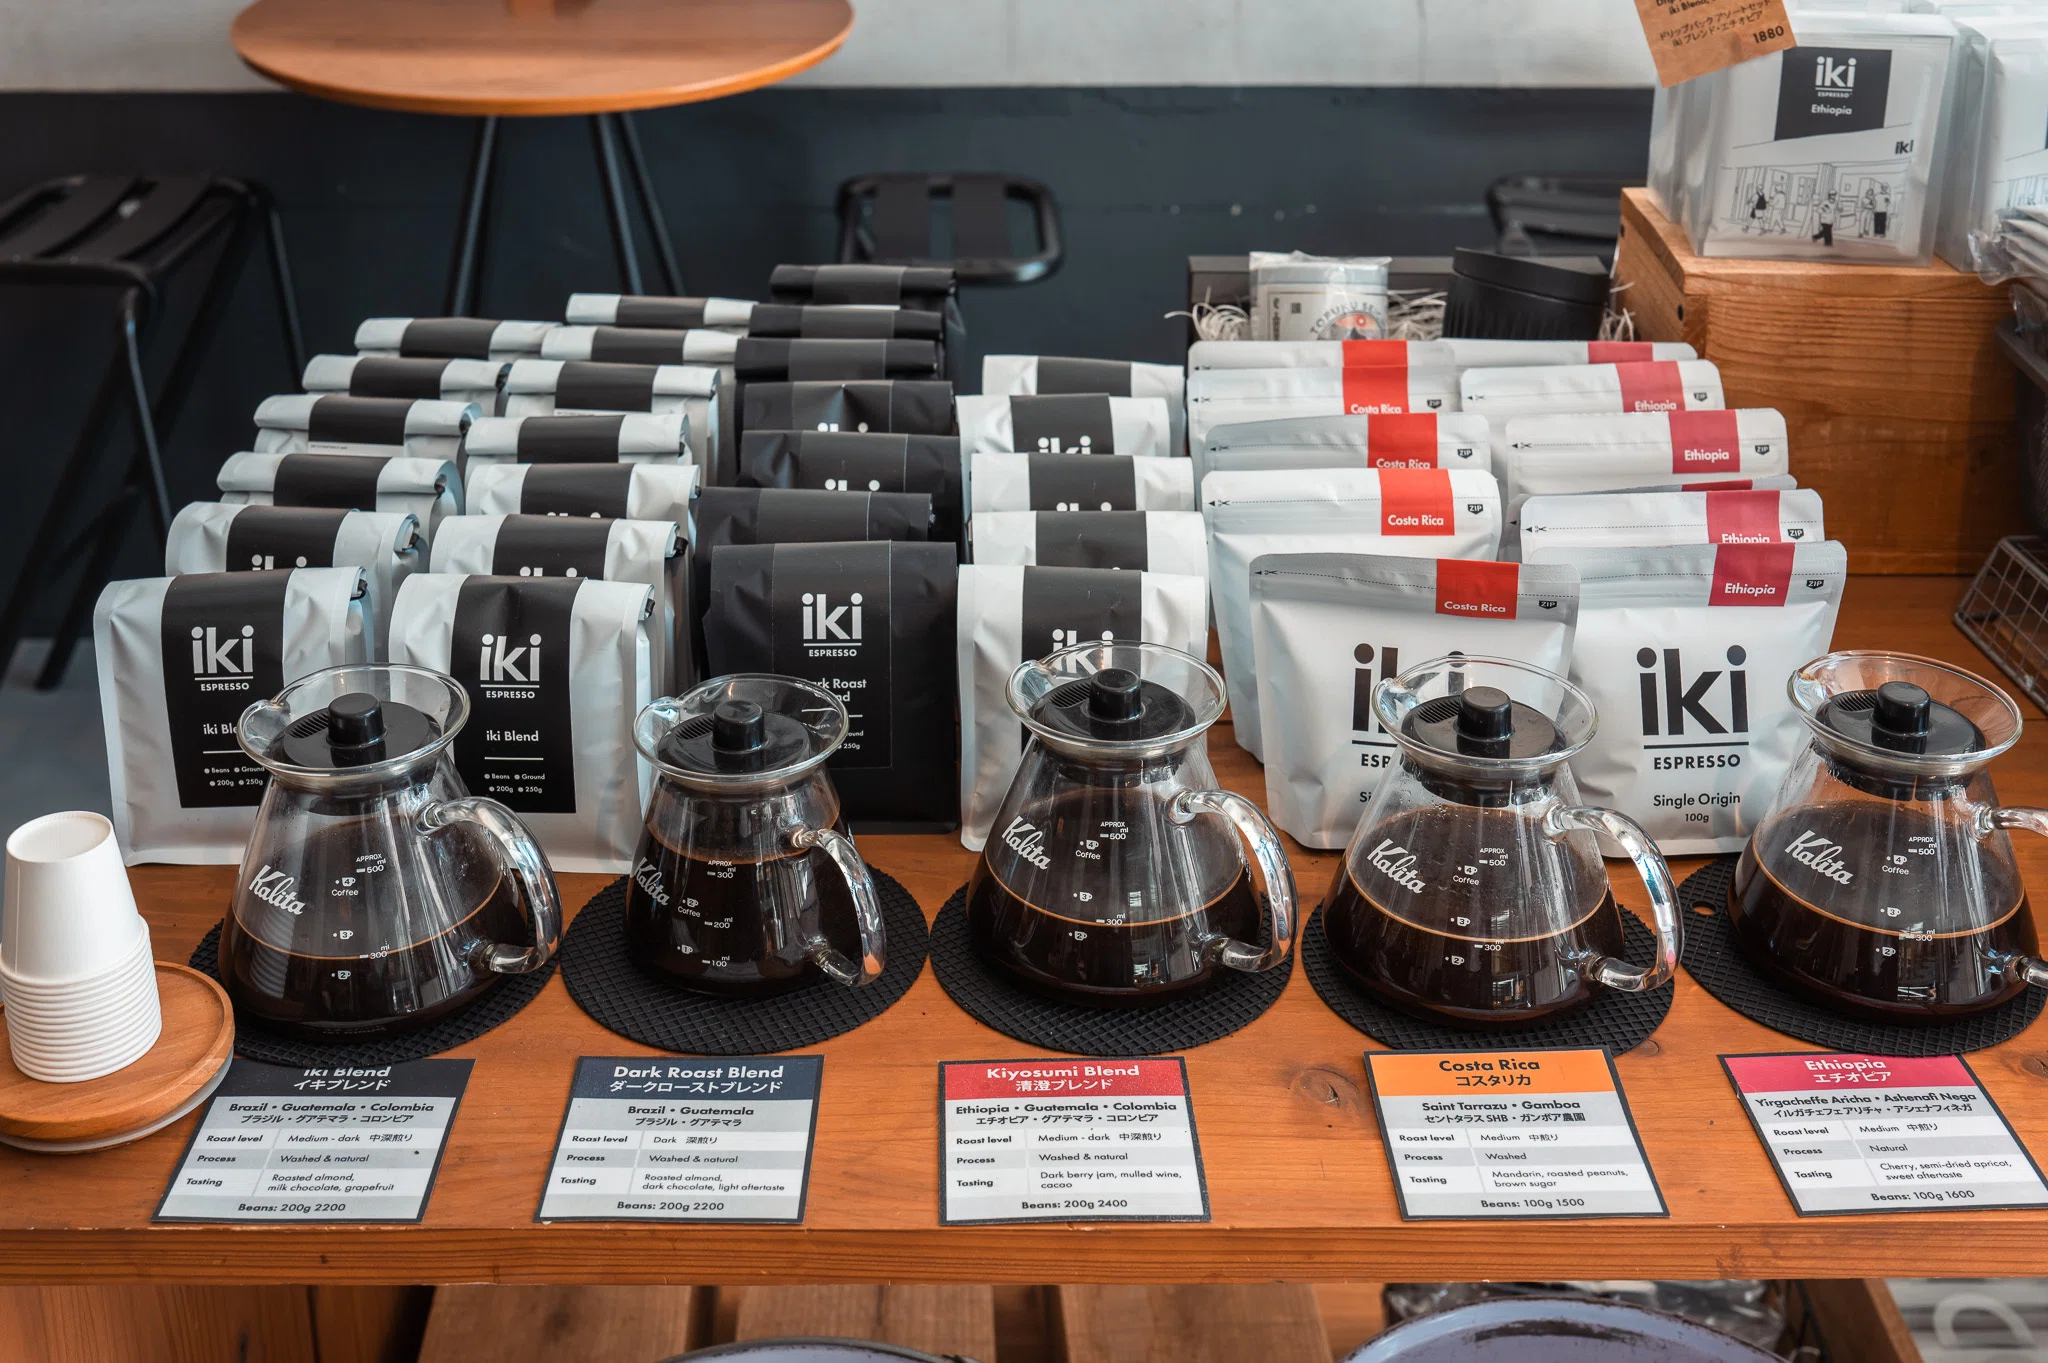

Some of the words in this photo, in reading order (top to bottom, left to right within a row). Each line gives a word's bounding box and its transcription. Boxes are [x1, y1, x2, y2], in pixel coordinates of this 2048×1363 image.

[1753, 26, 1784, 43] 1880
[1816, 56, 1856, 87] iki
[1811, 104, 1852, 116] Ethiopia
[1685, 449, 1729, 463] Ethiopia
[1388, 515, 1418, 526] Costa
[1422, 514, 1444, 526] Rica
[1725, 582, 1775, 596] Ethiopia
[1444, 601, 1478, 611] Costa
[1481, 603, 1505, 613] Rica
[802, 593, 863, 640] iki
[191, 625, 254, 674] iki
[480, 634, 542, 681] iki
[200, 682, 250, 691] ESPRESSO
[833, 679, 866, 688] Roast
[1636, 645, 1749, 736] iki
[203, 723, 217, 734] iki
[486, 730, 500, 741] iki
[505, 731, 538, 741] Blend
[1654, 754, 1740, 770] ESPRESSO
[1654, 794, 1695, 808] Single
[1698, 792, 1740, 808] Origin
[1684, 813, 1709, 823] 100g
[1002, 816, 1050, 870] Kalita
[356, 853, 382, 863] APPROX
[1076, 850, 1100, 860] Coffee
[1785, 830, 1853, 885] Kalita
[1367, 838, 1426, 894] Kalita
[630, 857, 670, 906] Kalita
[249, 865, 305, 915] Kalita
[370, 951, 387, 959] 300
[1439, 1060, 1493, 1072] Costa
[1499, 1059, 1540, 1070] Rica
[1804, 1059, 1887, 1071] Ethiopia
[334, 1067, 391, 1077] Blend
[614, 1066, 662, 1078] Dark
[668, 1067, 723, 1078] Roast
[728, 1066, 784, 1078] Blend
[987, 1066, 1078, 1080] Kiyosumi
[1084, 1065, 1140, 1077] Blend
[1456, 1074, 1532, 1087] コスタリカ
[1813, 1071, 1891, 1084] エチオピア
[294, 1079, 391, 1090] イキブレンド
[610, 1080, 783, 1094] ダークローストブレンド
[1016, 1079, 1112, 1092] 清澄ブレンド
[1755, 1095, 1829, 1108] Yirgacheffe
[1832, 1094, 1871, 1104] Aricha
[1884, 1092, 1938, 1102] Ashenafi
[1940, 1092, 1976, 1102] Nega
[229, 1103, 268, 1112] Brazil
[282, 1104, 356, 1112] Guatemala
[370, 1103, 434, 1111] Colombia
[956, 1105, 1010, 1115] Ethiopia
[1024, 1102, 1098, 1112] Guatemala
[1114, 1102, 1177, 1111] Colombia
[1422, 1102, 1455, 1111] Saint
[1456, 1102, 1508, 1111] Tarrazu
[1522, 1100, 1580, 1110] Gamboa
[628, 1106, 666, 1115] Brazil
[680, 1106, 754, 1116] Guatemala
[241, 1115, 414, 1123] ブラジル・グアテマラ・コロンビア
[635, 1118, 742, 1127] ブラジル・グアテマラ
[1774, 1128, 1802, 1136] Roast
[1804, 1127, 1830, 1135] level
[1859, 1124, 1900, 1133] Medium
[238, 1134, 263, 1142] level
[338, 1134, 360, 1142] dark
[654, 1136, 676, 1144] Dark
[988, 1136, 1012, 1144] level
[1038, 1134, 1078, 1142] Medium
[1088, 1134, 1110, 1142] dark
[1430, 1134, 1455, 1142] level
[1480, 1134, 1520, 1142] Medium
[1783, 1147, 1823, 1155] Process
[1870, 1144, 1908, 1153] Natural
[334, 1154, 370, 1162] natural
[566, 1154, 605, 1162] Process
[650, 1155, 690, 1163] Washed
[956, 1156, 996, 1164] Process
[1404, 1154, 1443, 1162] Process
[1486, 1153, 1526, 1161] Washed
[1880, 1162, 1918, 1172] Cherry,
[1919, 1160, 1971, 1169] semi-dried
[1973, 1160, 2012, 1170] apricot,
[272, 1174, 312, 1182] Roasted
[314, 1173, 354, 1182] almond,
[644, 1174, 682, 1182] Roasted
[684, 1174, 722, 1182] almond,
[1067, 1171, 1094, 1180] berry
[1096, 1171, 1118, 1180] jam,
[1156, 1171, 1182, 1179] wine,
[1492, 1170, 1544, 1179] Mandarin,
[1547, 1169, 1584, 1178] roasted
[1586, 1169, 1628, 1179] peanuts,
[1795, 1170, 1832, 1180] Tasting
[1886, 1172, 1916, 1180] sweet
[1917, 1170, 1962, 1179] aftertaste
[186, 1178, 223, 1187] Tasting
[560, 1176, 596, 1186] Tasting
[956, 1178, 994, 1188] Tasting
[1410, 1176, 1447, 1185] Tasting
[1494, 1180, 1527, 1188] brown
[1530, 1180, 1557, 1189] sugar
[290, 1183, 342, 1192] chocolate,
[345, 1183, 394, 1193] grapefruit
[642, 1182, 664, 1190] dark
[666, 1183, 715, 1192] chocolate,
[718, 1183, 738, 1192] light
[740, 1184, 784, 1192] aftertaste
[1870, 1191, 1912, 1201] Beans:
[1914, 1190, 1944, 1202] 100g
[1946, 1189, 1975, 1199] 1600
[280, 1204, 311, 1213] 200g
[617, 1202, 656, 1210] Beans:
[660, 1202, 690, 1212] 200g
[693, 1202, 724, 1211] 2200
[1022, 1201, 1061, 1210] Beans:
[1064, 1200, 1094, 1210] 200g
[1098, 1200, 1128, 1208] 2400
[1481, 1199, 1520, 1208] Beans:
[1524, 1199, 1553, 1209] 100g
[1556, 1198, 1584, 1207] 1500
